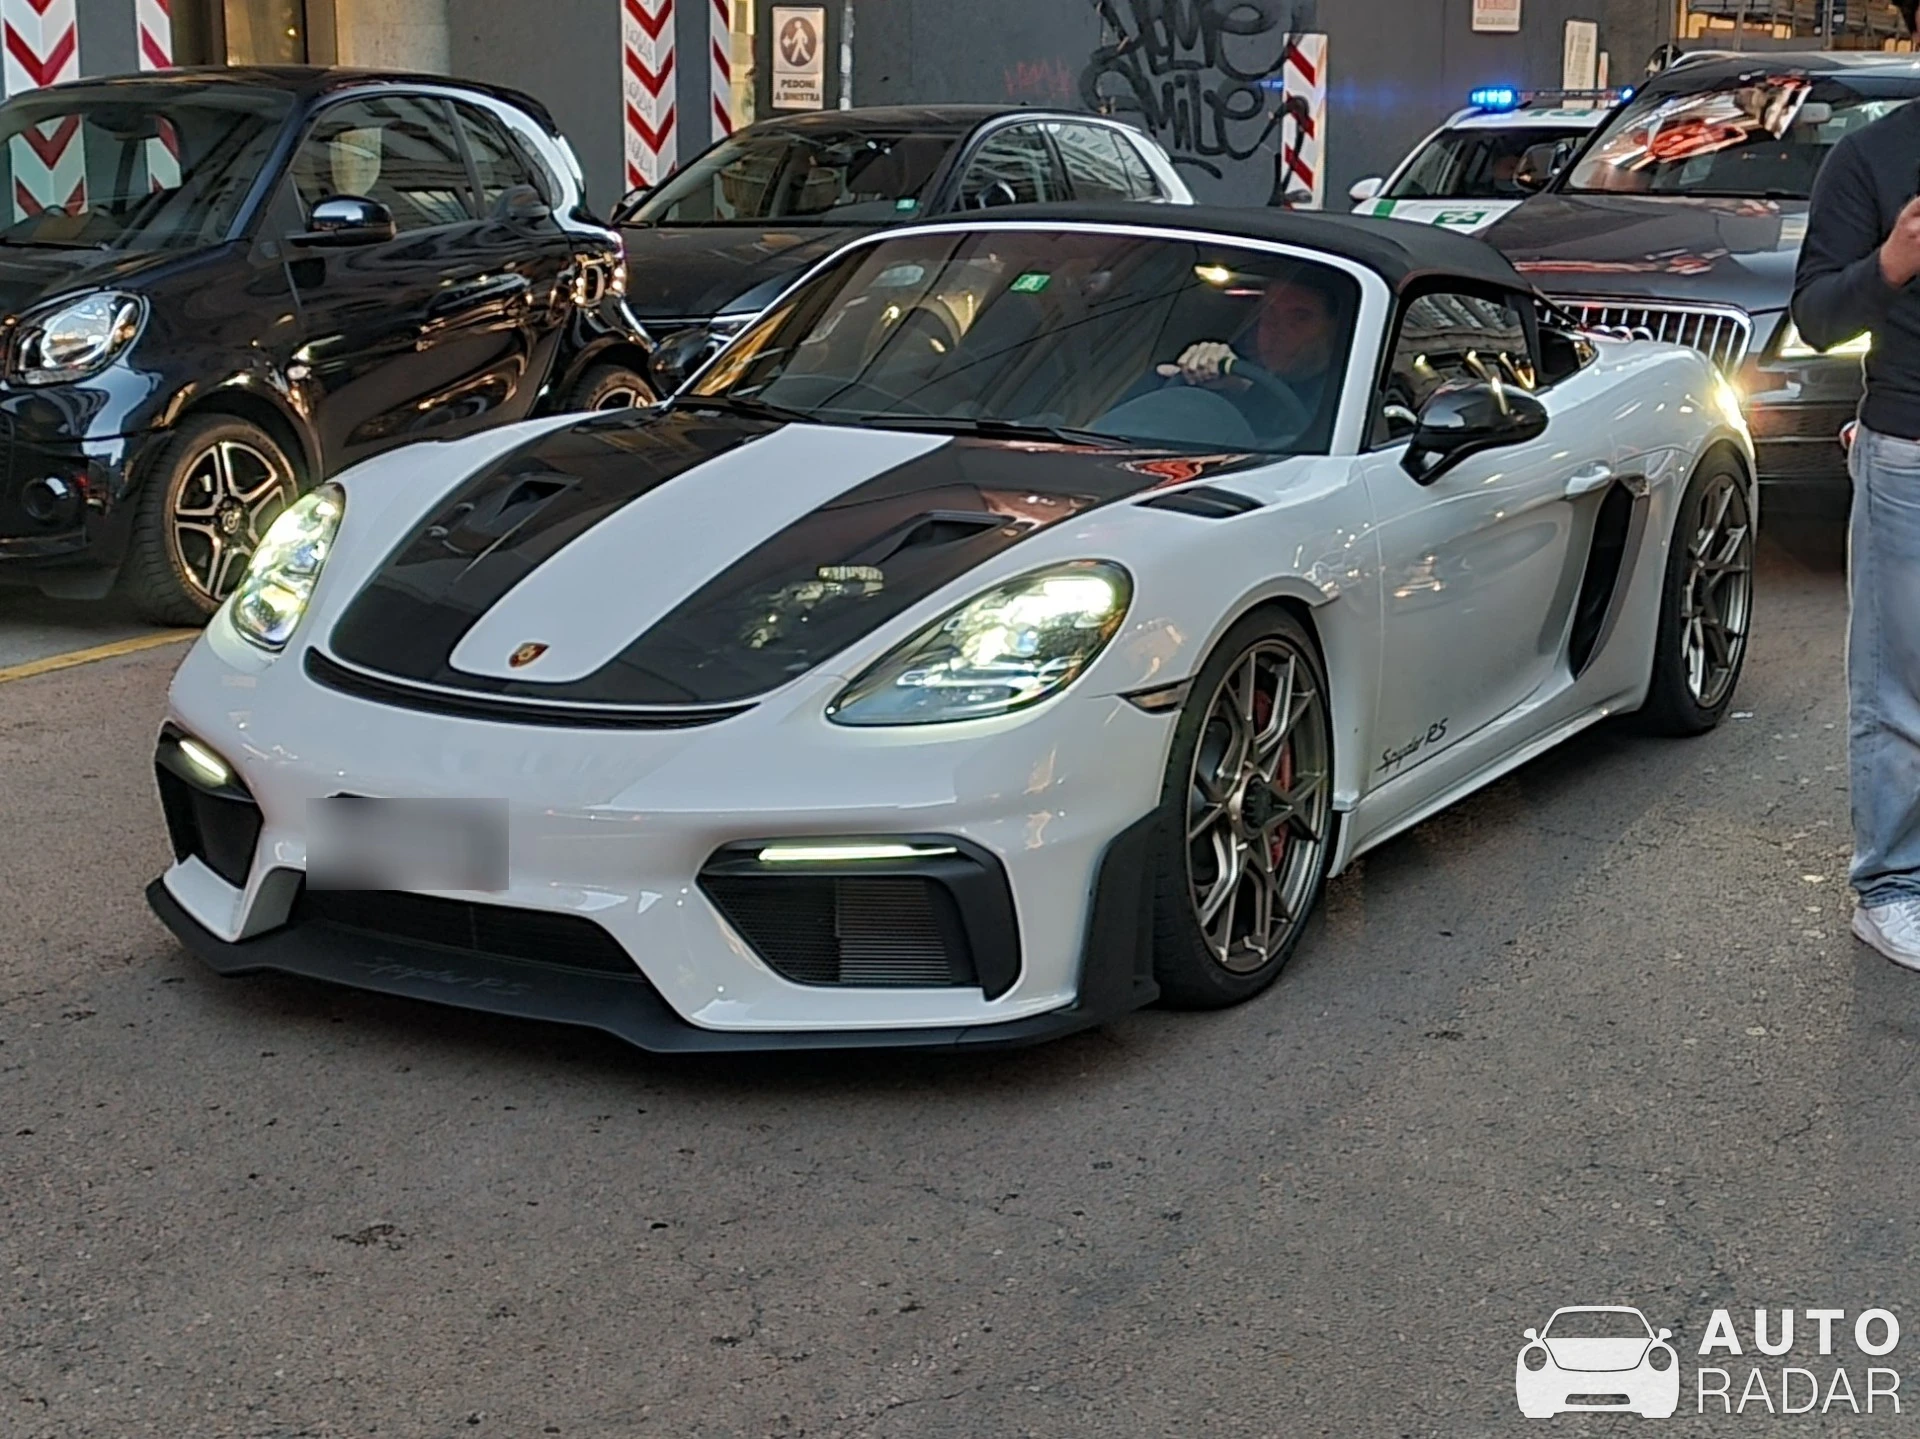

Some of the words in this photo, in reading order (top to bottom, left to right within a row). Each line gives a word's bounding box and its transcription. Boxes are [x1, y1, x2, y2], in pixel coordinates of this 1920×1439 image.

[780, 79, 816, 89] PEDONI
[775, 91, 781, 100] A
[1424, 717, 1448, 746] RS
